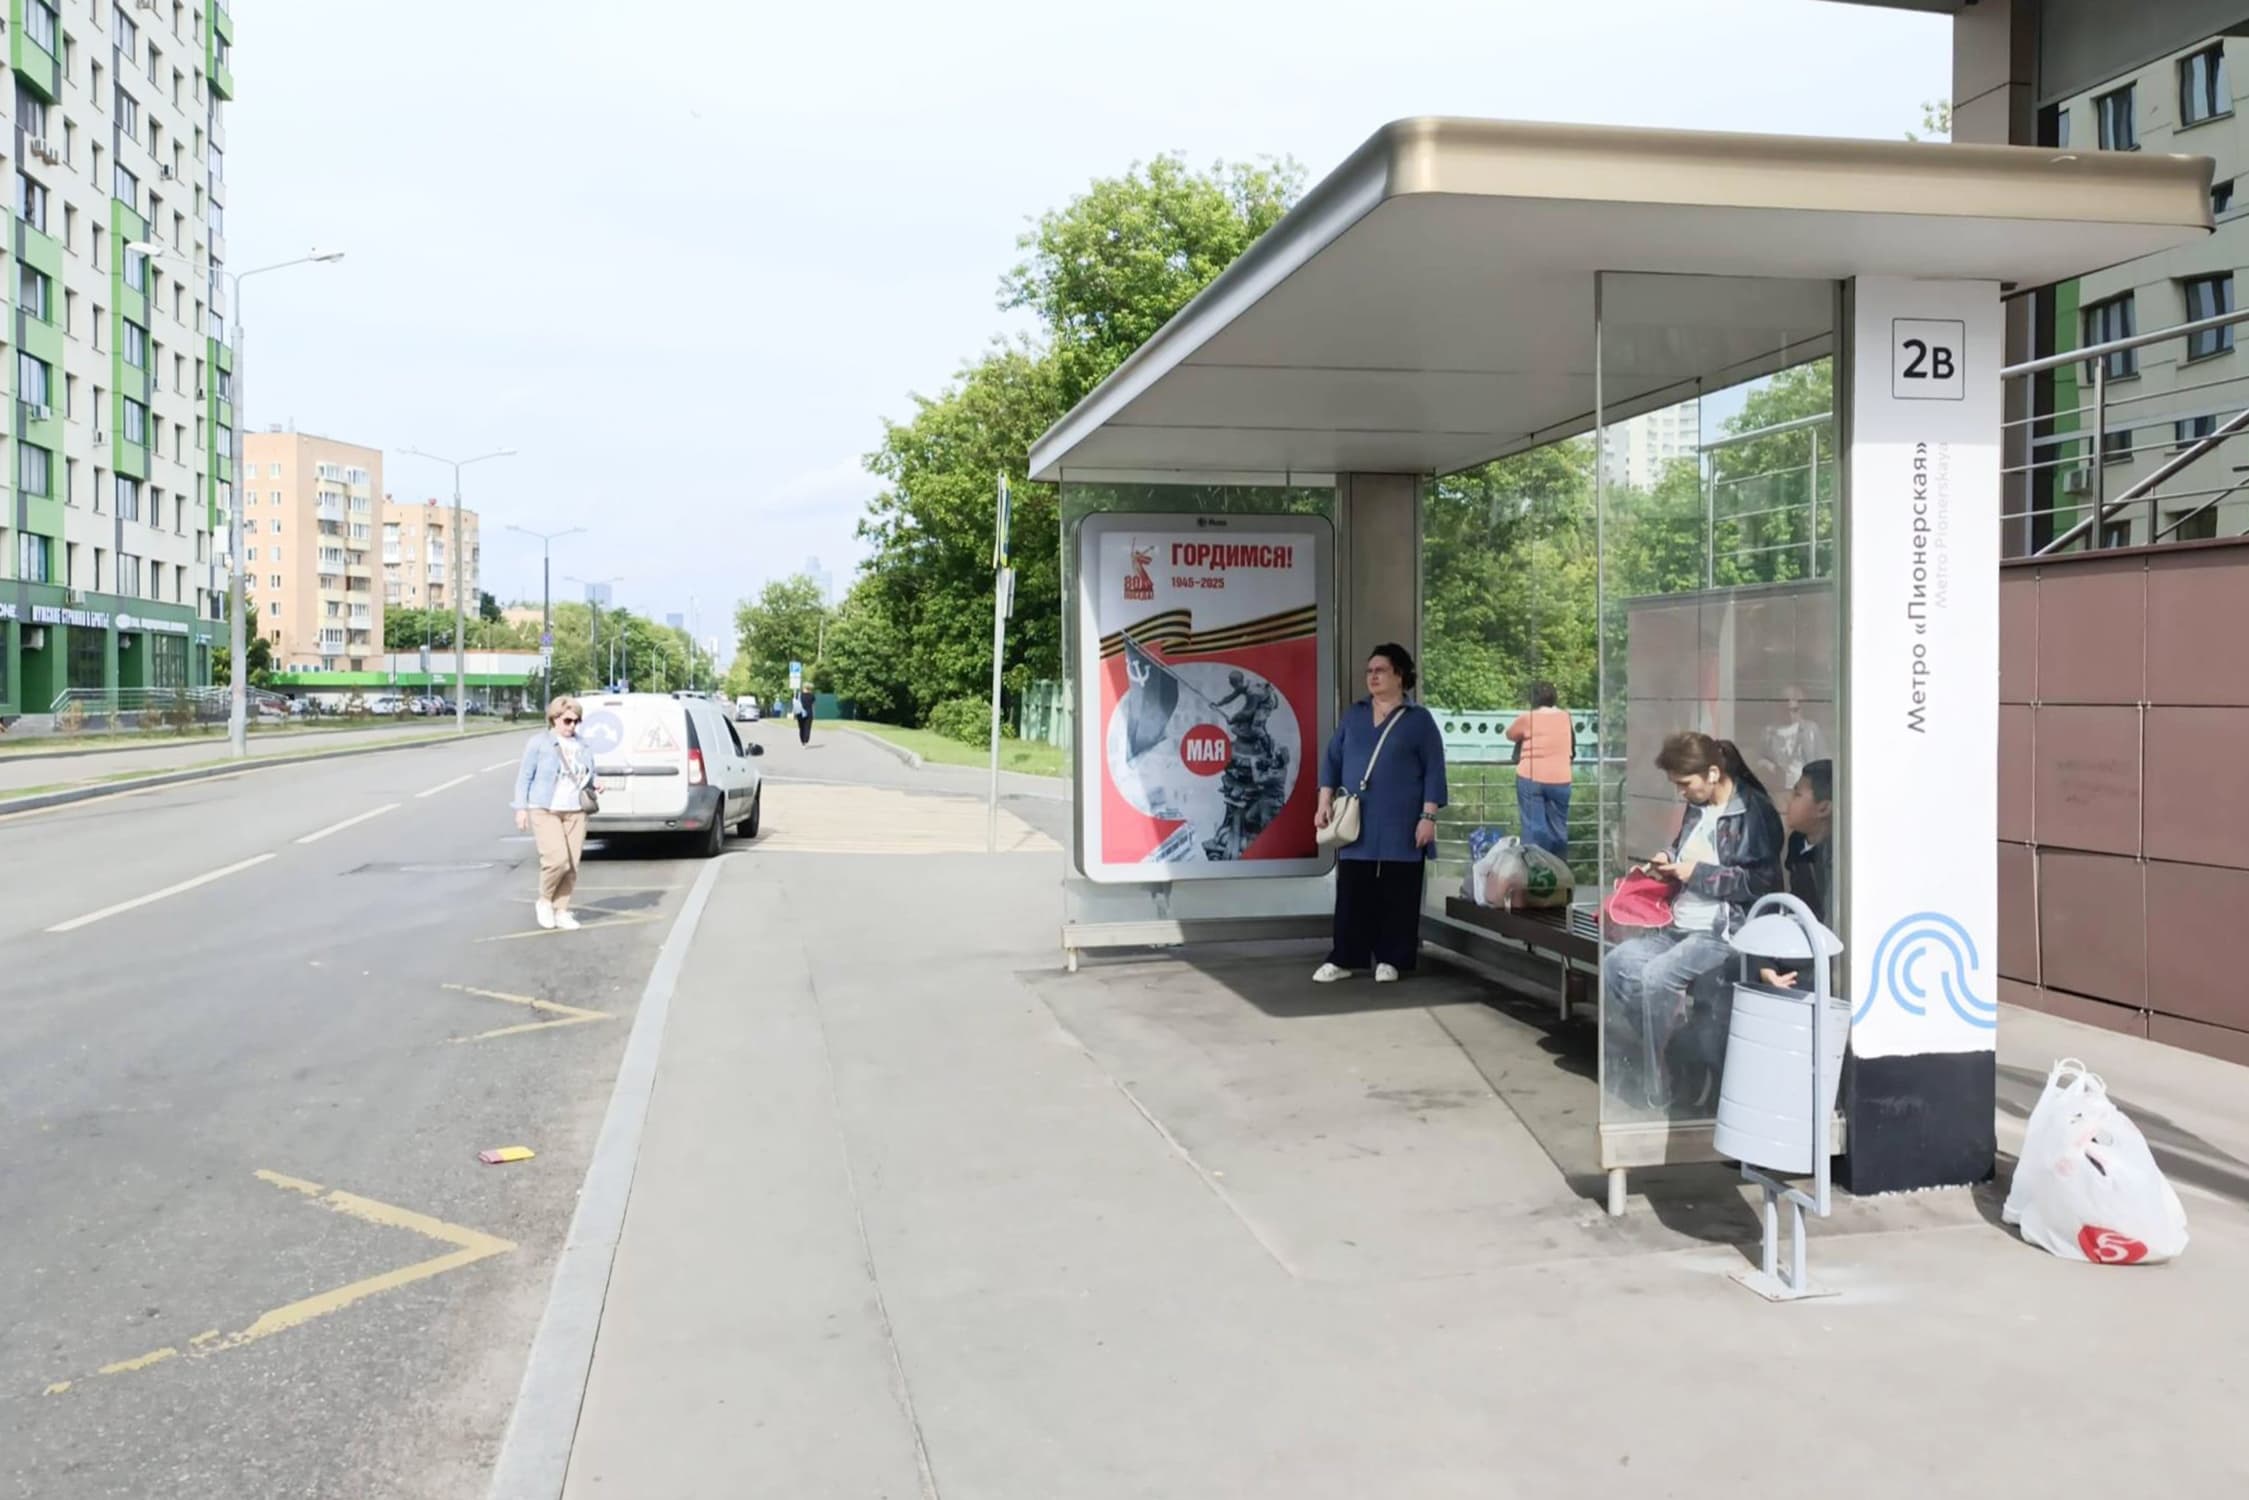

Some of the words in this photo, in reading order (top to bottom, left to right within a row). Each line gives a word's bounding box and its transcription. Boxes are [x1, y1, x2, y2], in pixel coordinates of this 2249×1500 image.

[1907, 442, 1931, 635] «Пионерская»
[1171, 543, 1293, 570] ГОРДИМСЯ!
[1171, 576, 1225, 589] 1945-2025
[1907, 643, 1930, 734] Метро
[1187, 738, 1226, 762] МАЯ
